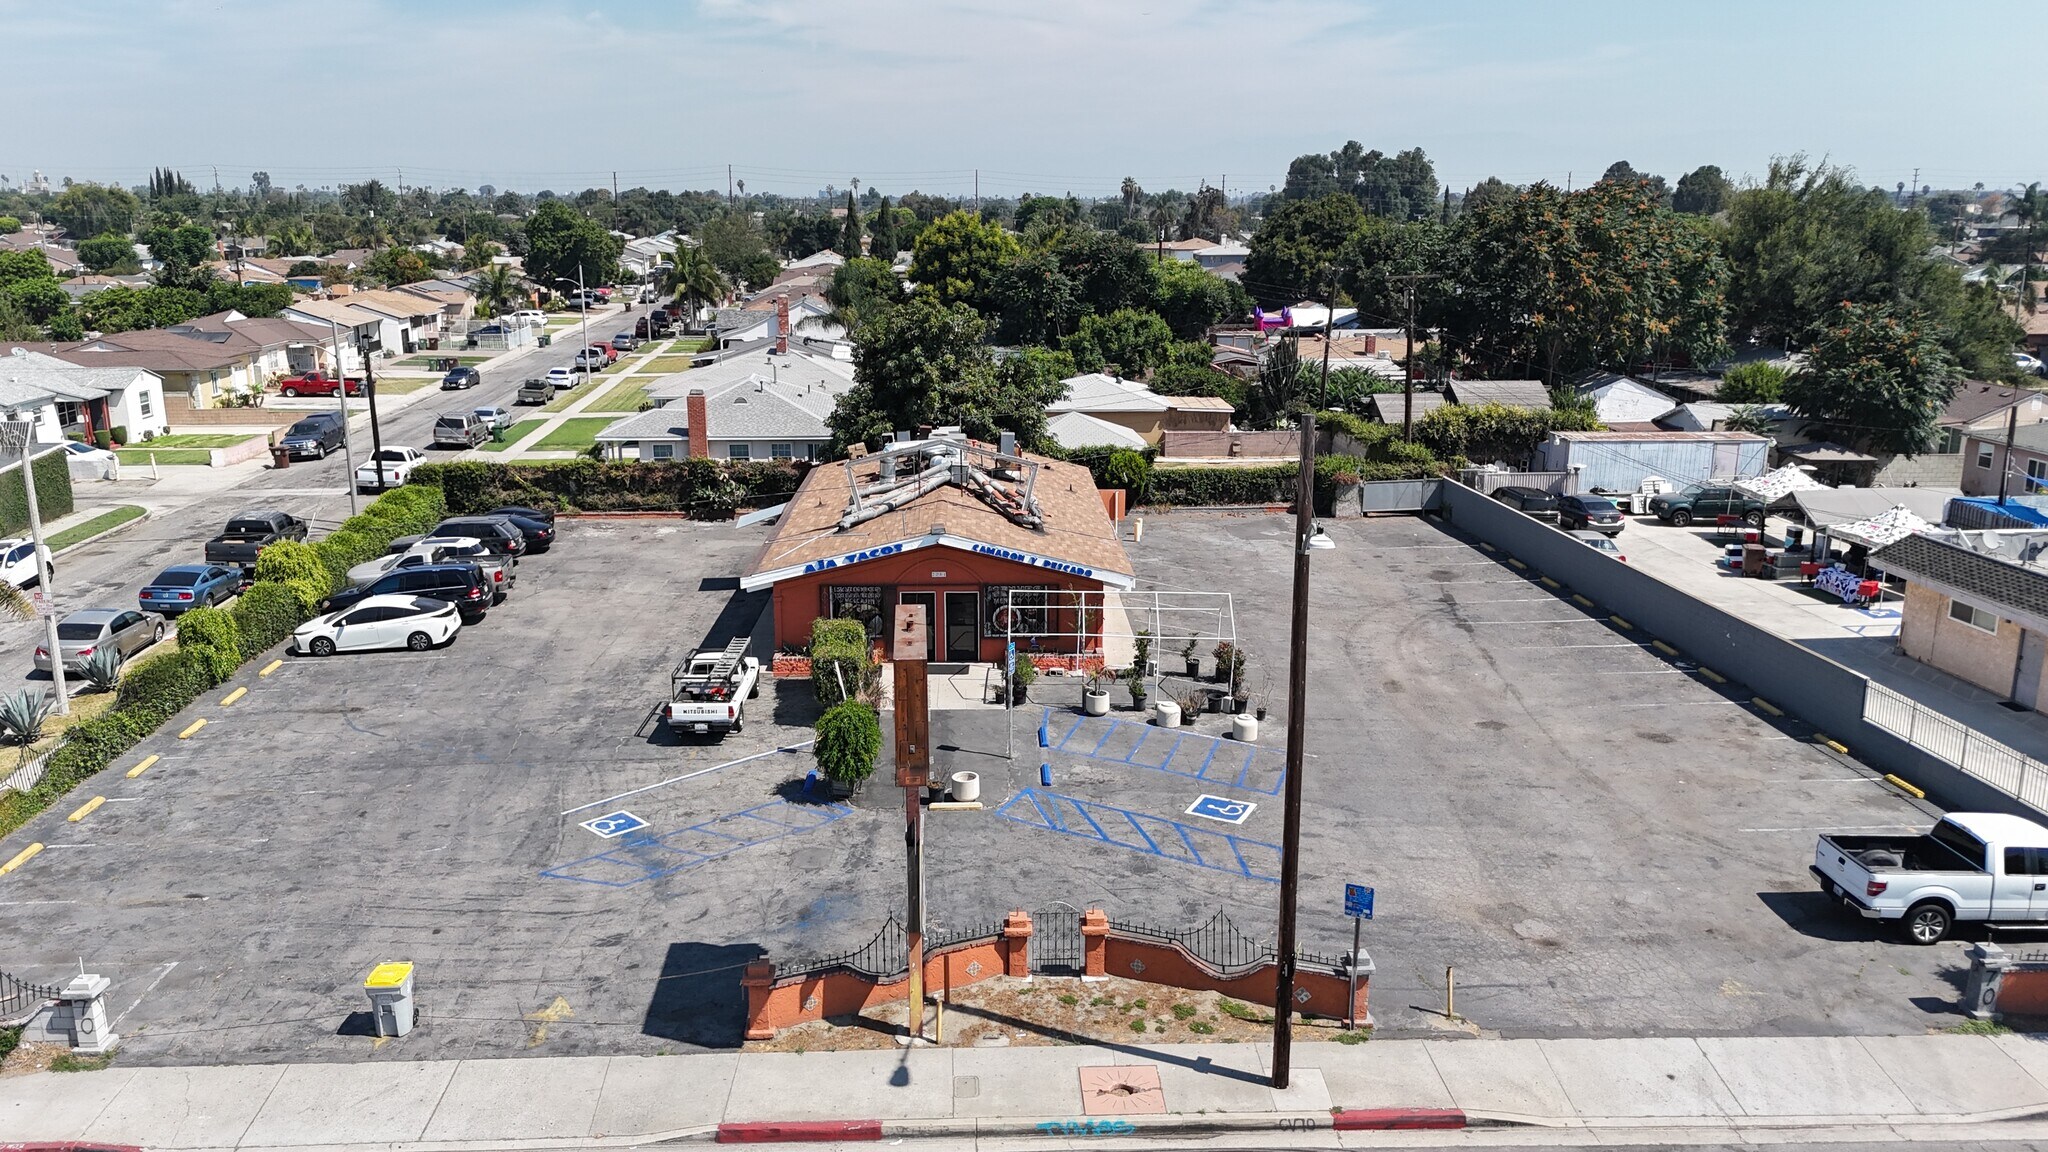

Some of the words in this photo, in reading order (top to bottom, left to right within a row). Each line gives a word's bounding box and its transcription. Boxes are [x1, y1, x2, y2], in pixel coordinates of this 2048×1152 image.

[843, 544, 903, 563] TACOS
[972, 544, 1025, 562] CAMARON
[1029, 556, 1038, 565] Y
[1043, 560, 1093, 577] PESCADO
